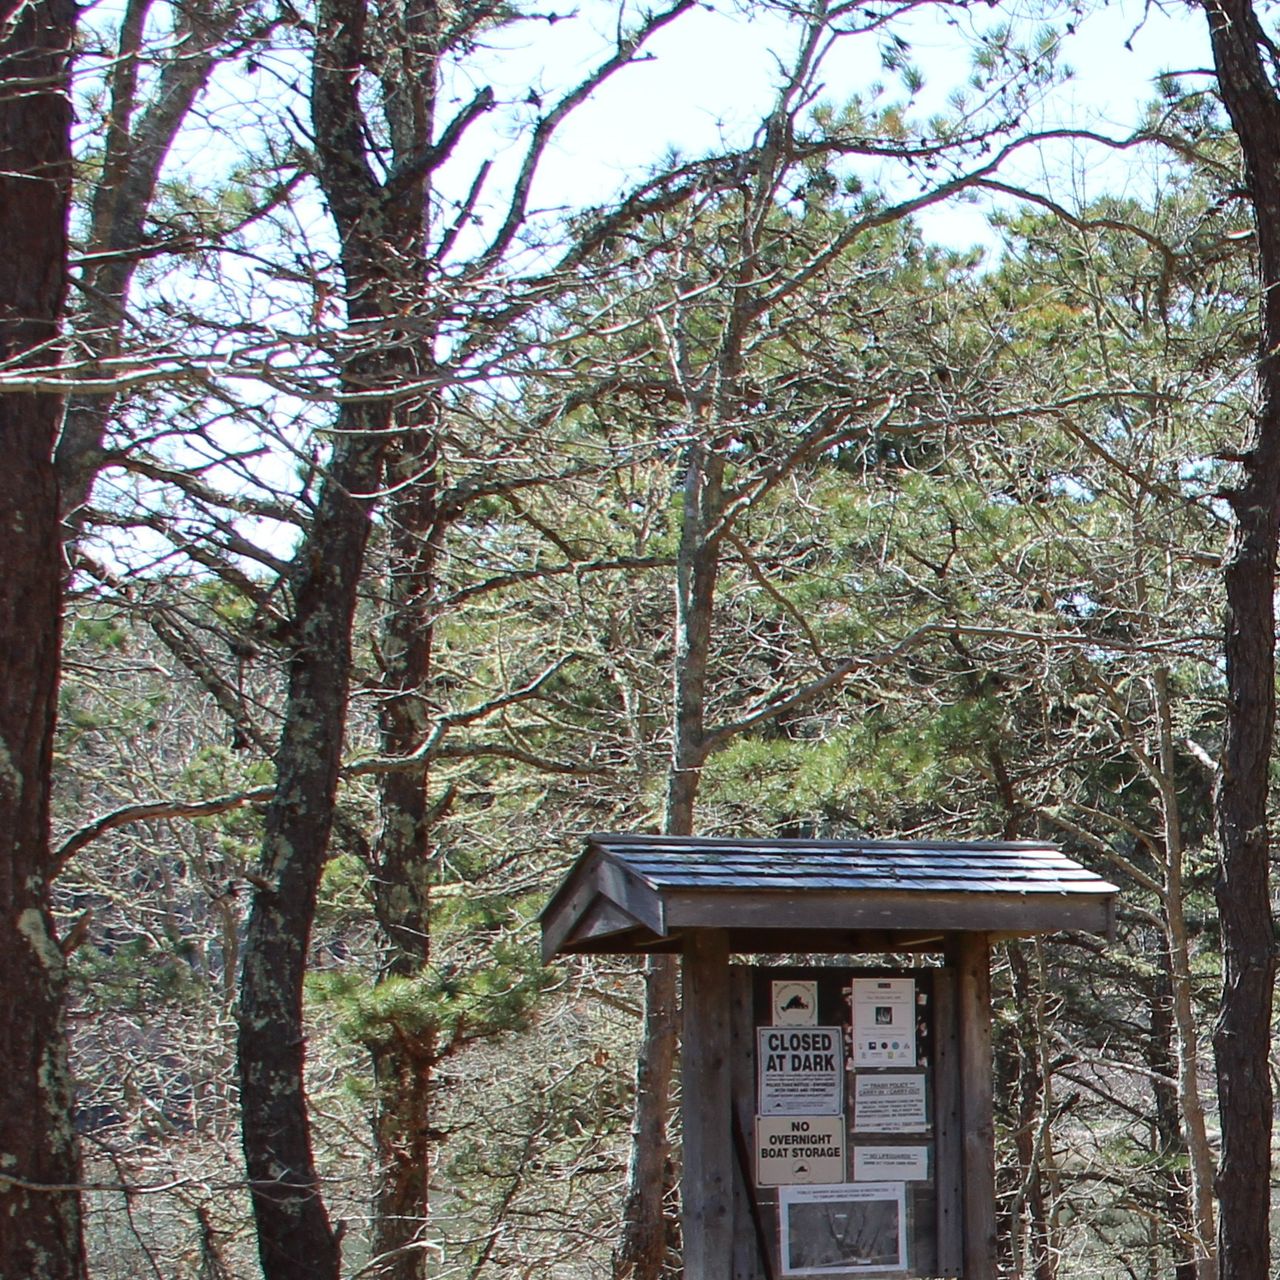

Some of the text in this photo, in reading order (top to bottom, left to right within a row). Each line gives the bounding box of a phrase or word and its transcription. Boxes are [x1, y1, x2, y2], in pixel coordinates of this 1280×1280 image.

[768, 1033, 832, 1051] CLOSED
[767, 1054, 836, 1072] AT DARK
[791, 1121, 810, 1132] NO
[769, 1134, 832, 1145] OVERNIGHT
[761, 1147, 841, 1158] BOAT STORAGE
